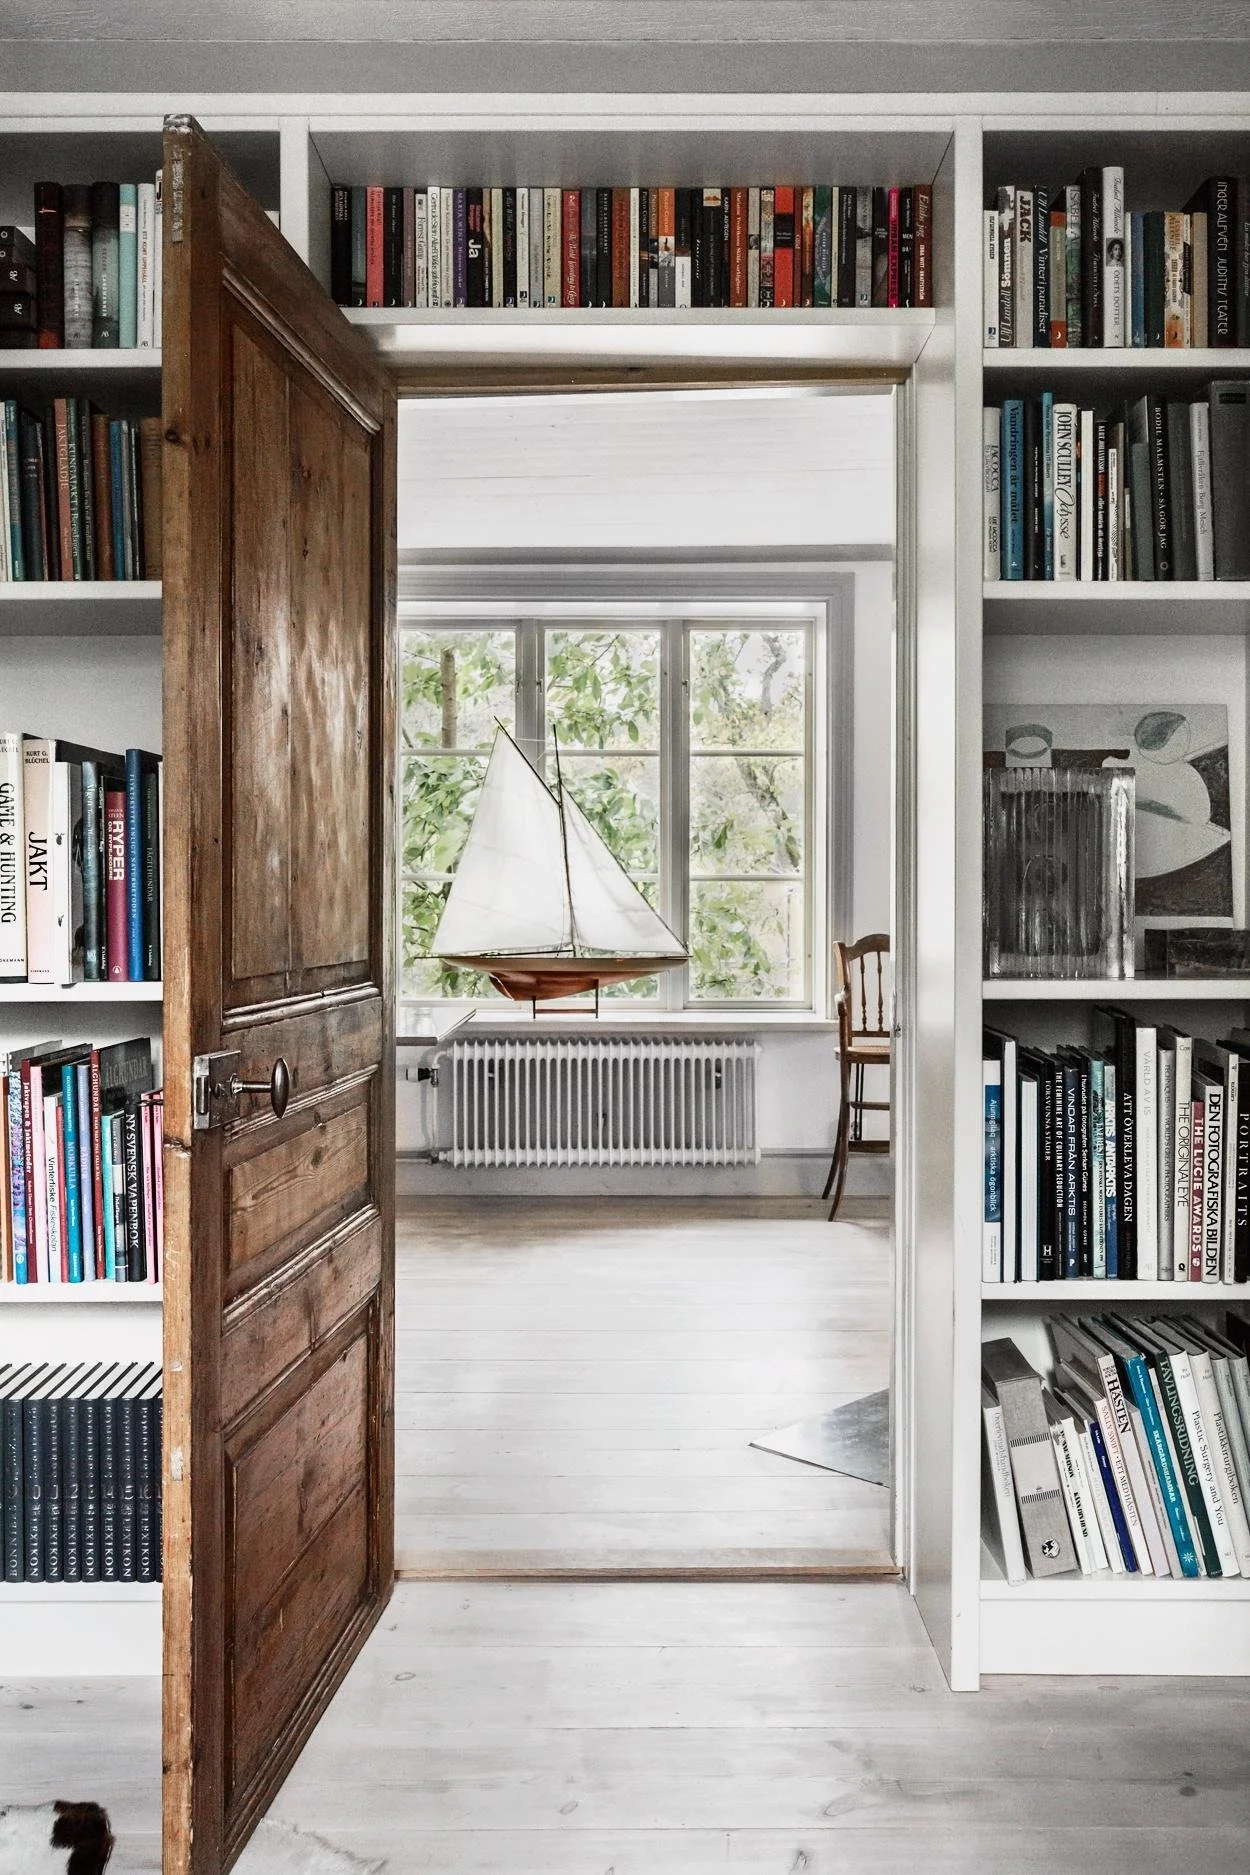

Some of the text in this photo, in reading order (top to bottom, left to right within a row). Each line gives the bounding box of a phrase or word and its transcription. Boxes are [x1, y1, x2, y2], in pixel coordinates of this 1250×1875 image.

[1019, 196, 1031, 243] JACK
[1217, 182, 1227, 211] INGER
[417, 217, 426, 239] Forrest
[468, 239, 481, 258] Ja
[1001, 238, 1011, 287] Sömnen
[1039, 248, 1047, 280] Vinter
[1217, 257, 1227, 296] JUDITHS
[1037, 286, 1048, 334] paradiset
[1217, 300, 1227, 335] TEATER
[1154, 407, 1162, 436] BODIL
[991, 445, 999, 492] IACOCCA
[1008, 405, 1020, 524] Vandringen är målet
[1054, 411, 1075, 539] JOHN SCULLEY Odyssé
[1156, 439, 1164, 490] MALMSTEN
[1158, 532, 1167, 549] JAG
[1159, 511, 1167, 530] GÖR
[108, 821, 112, 832] OG
[28, 831, 48, 891] JAKT
[113, 821, 124, 880] RYPER
[0, 851, 16, 924] HUNTING
[23, 1082, 32, 1119] Jaktvapen
[1143, 1051, 1153, 1116] VÄRLD AV IS
[1080, 1106, 1087, 1114] på
[24, 1129, 33, 1174] Jaktmetoder
[1056, 1131, 1063, 1139] OF
[1068, 1137, 1077, 1170] FRÅN
[1105, 1101, 1117, 1197] ARKTIS ANTARKTIS
[1123, 1093, 1134, 1222] ATT ÖVERLEVA DAGEN
[1178, 1101, 1190, 1207] THE ORIGINAL EYE
[47, 1157, 56, 1203] Vinterfiske
[67, 1141, 75, 1190] MORKULLA
[124, 1114, 139, 1249] NY SVENSK VAPENBOK
[989, 1147, 998, 1175] arktiska
[1206, 1093, 1221, 1276] DEN FOTOGRAFISKA BILDEN
[1237, 1113, 1249, 1227] PORTRAITS
[989, 1177, 998, 1212] ögonblick
[1056, 1174, 1064, 1208] SEDUCTION
[1068, 1173, 1076, 1216] ARKTIS
[1192, 1119, 1204, 1252] THE LUCIE AWARDS
[1106, 1377, 1131, 1434] HÄSTEN
[1159, 1357, 1199, 1487] TÄVLINGSRIDNING
[1192, 1410, 1224, 1526] Plastic Surgery and You
[1213, 1412, 1238, 1505] Plastikkirurgiboken
